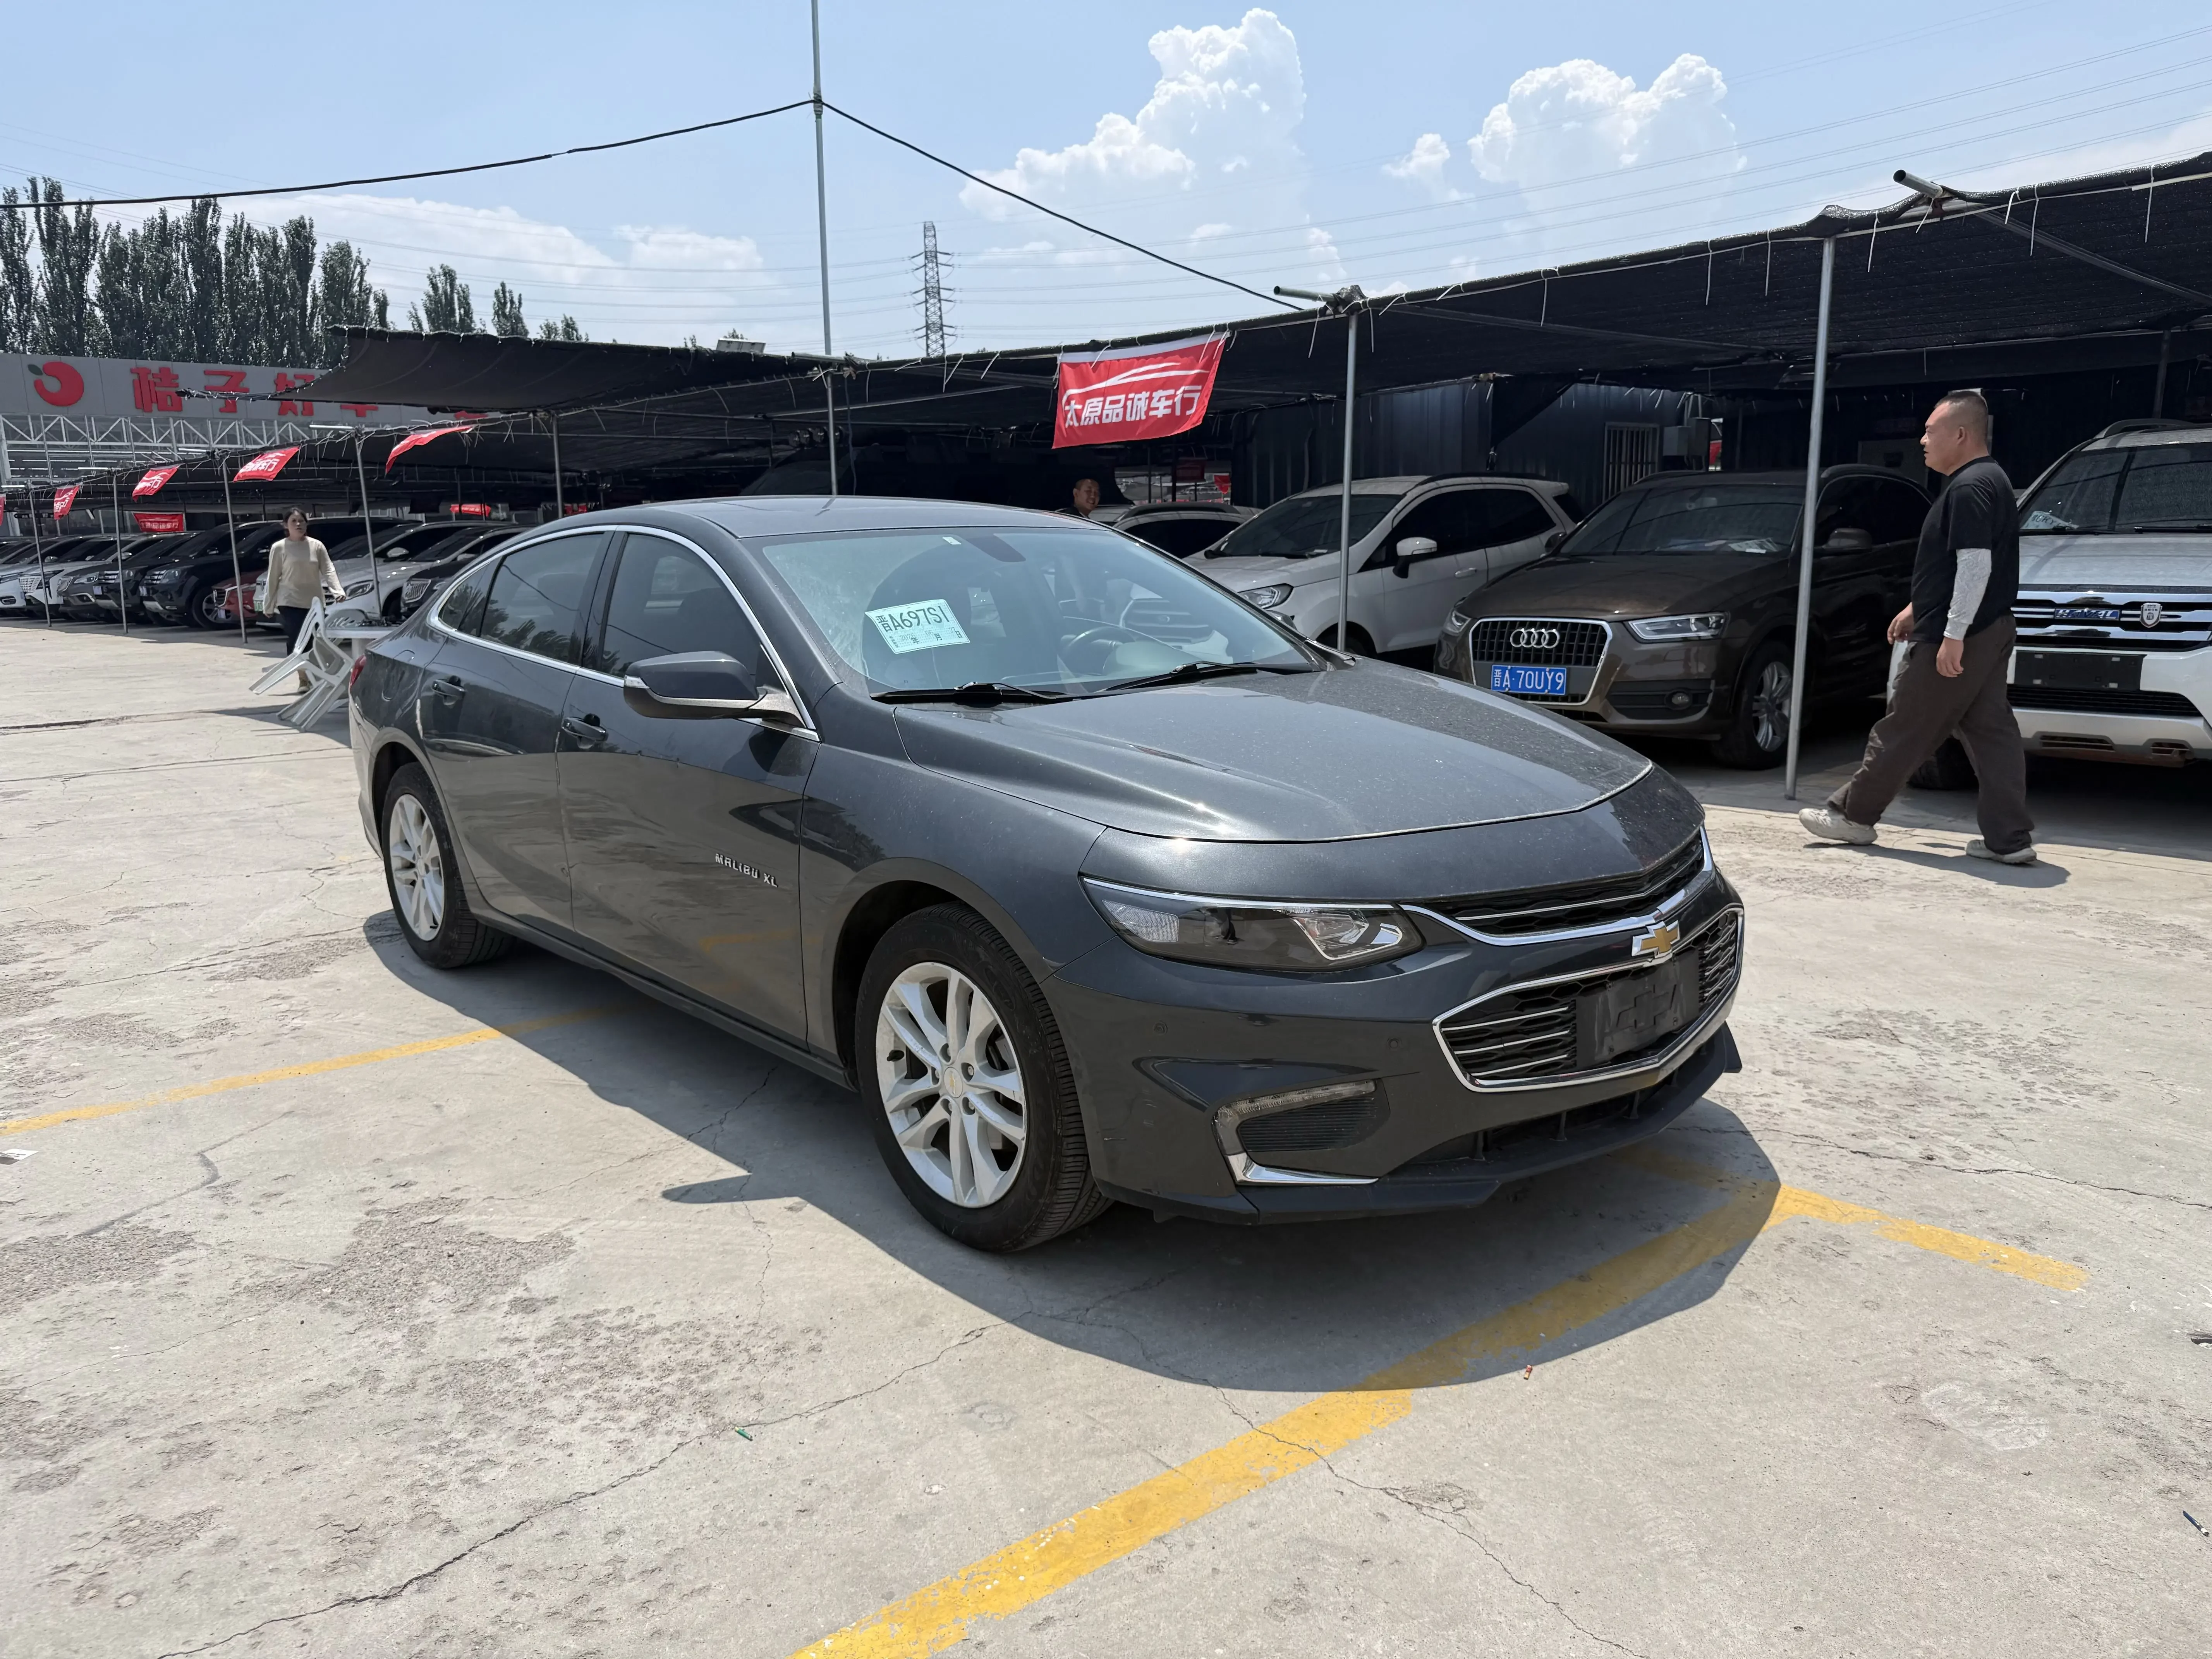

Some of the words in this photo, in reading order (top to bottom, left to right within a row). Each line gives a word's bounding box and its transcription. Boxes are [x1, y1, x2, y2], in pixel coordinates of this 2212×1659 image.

[130, 367, 378, 417] 桔子好
[1065, 385, 1202, 428] 太原品诚车行
[715, 853, 758, 878] MALIBU
[764, 873, 778, 887] XL
